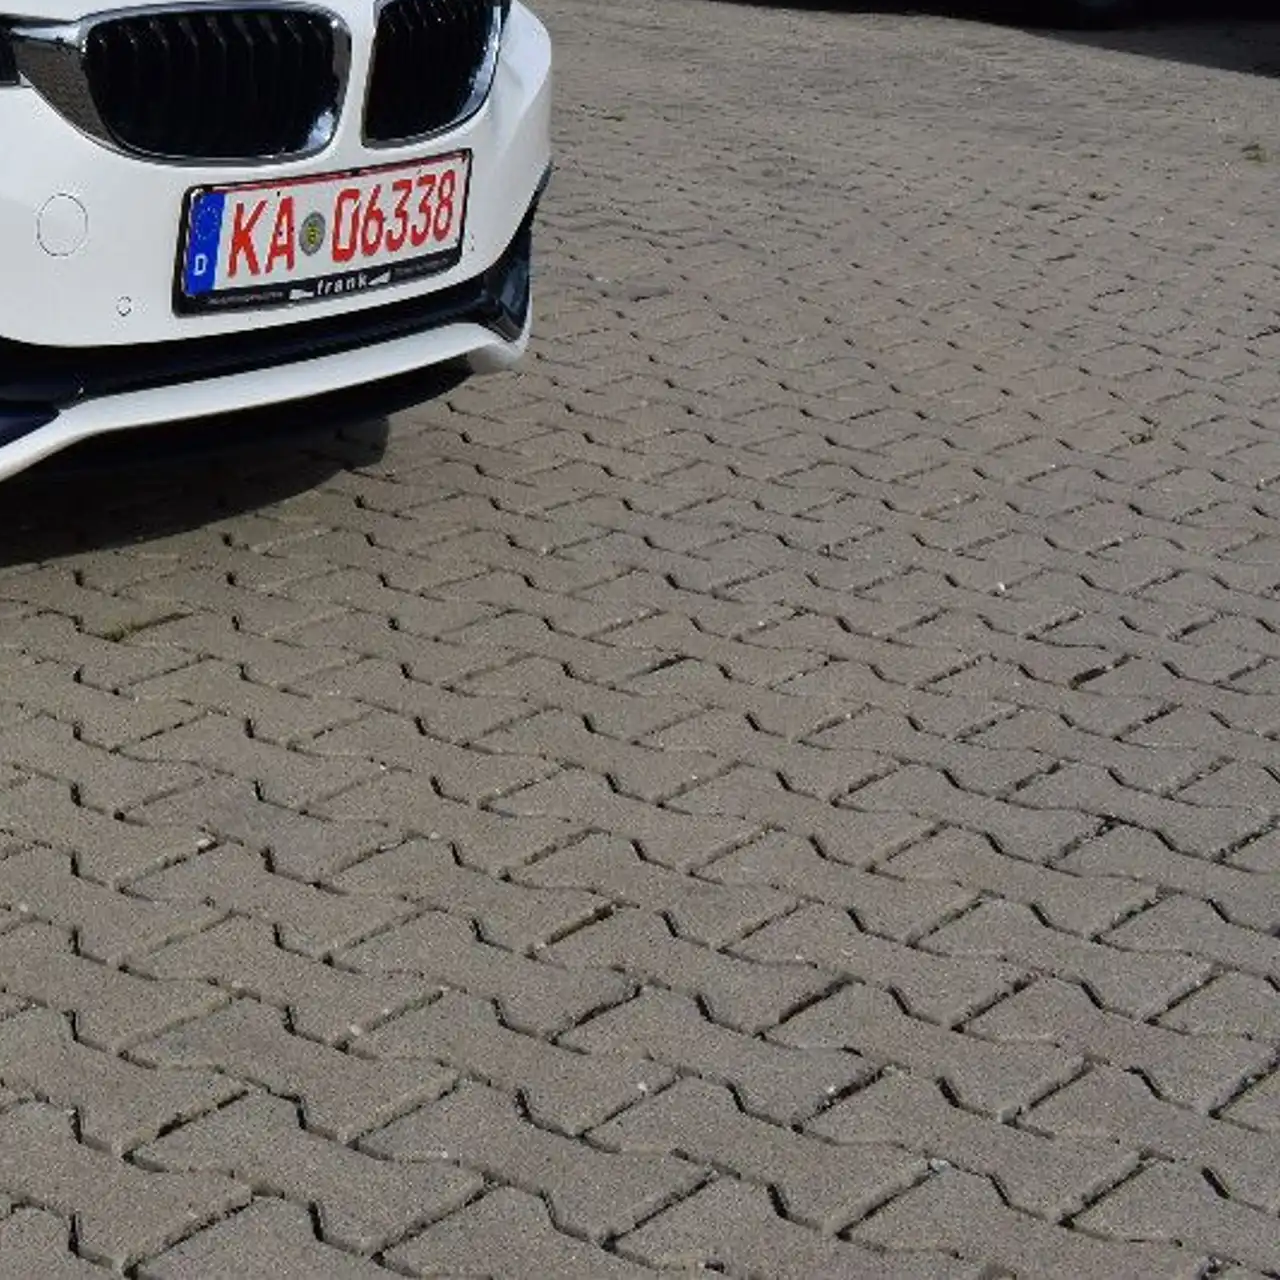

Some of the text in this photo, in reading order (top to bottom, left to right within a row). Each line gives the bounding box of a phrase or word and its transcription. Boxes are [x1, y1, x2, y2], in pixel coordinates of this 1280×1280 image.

[227, 168, 456, 279] KA 06338
[193, 253, 208, 276] D
[316, 273, 368, 296] frank
